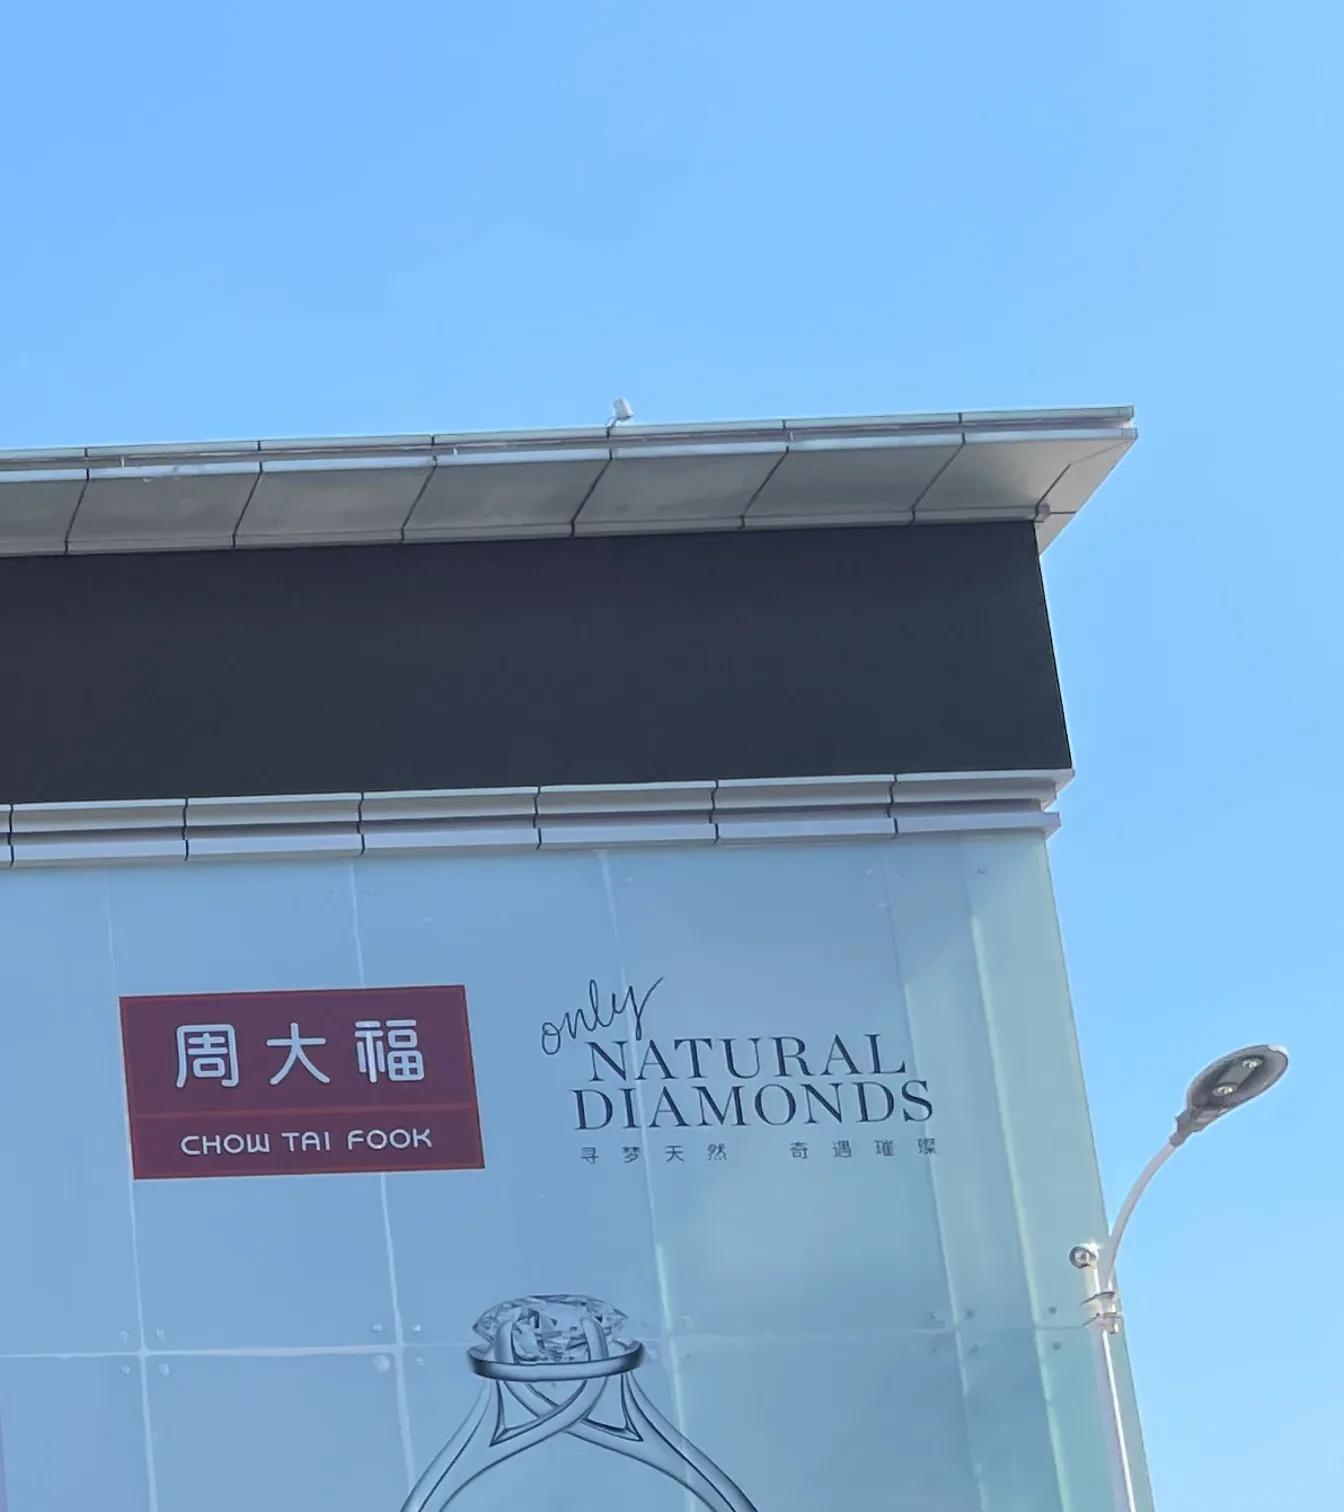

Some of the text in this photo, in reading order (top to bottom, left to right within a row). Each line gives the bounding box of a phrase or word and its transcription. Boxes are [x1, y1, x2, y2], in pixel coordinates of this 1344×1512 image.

[541, 976, 664, 1055] only
[175, 1018, 425, 1088] 周大福
[584, 1033, 906, 1082] NATURAL
[569, 1079, 934, 1131] DIAMONDS
[180, 1127, 433, 1156] CHOW TAI FOOK
[580, 1137, 936, 1164] 寻梦天然 奇遇璀璨
